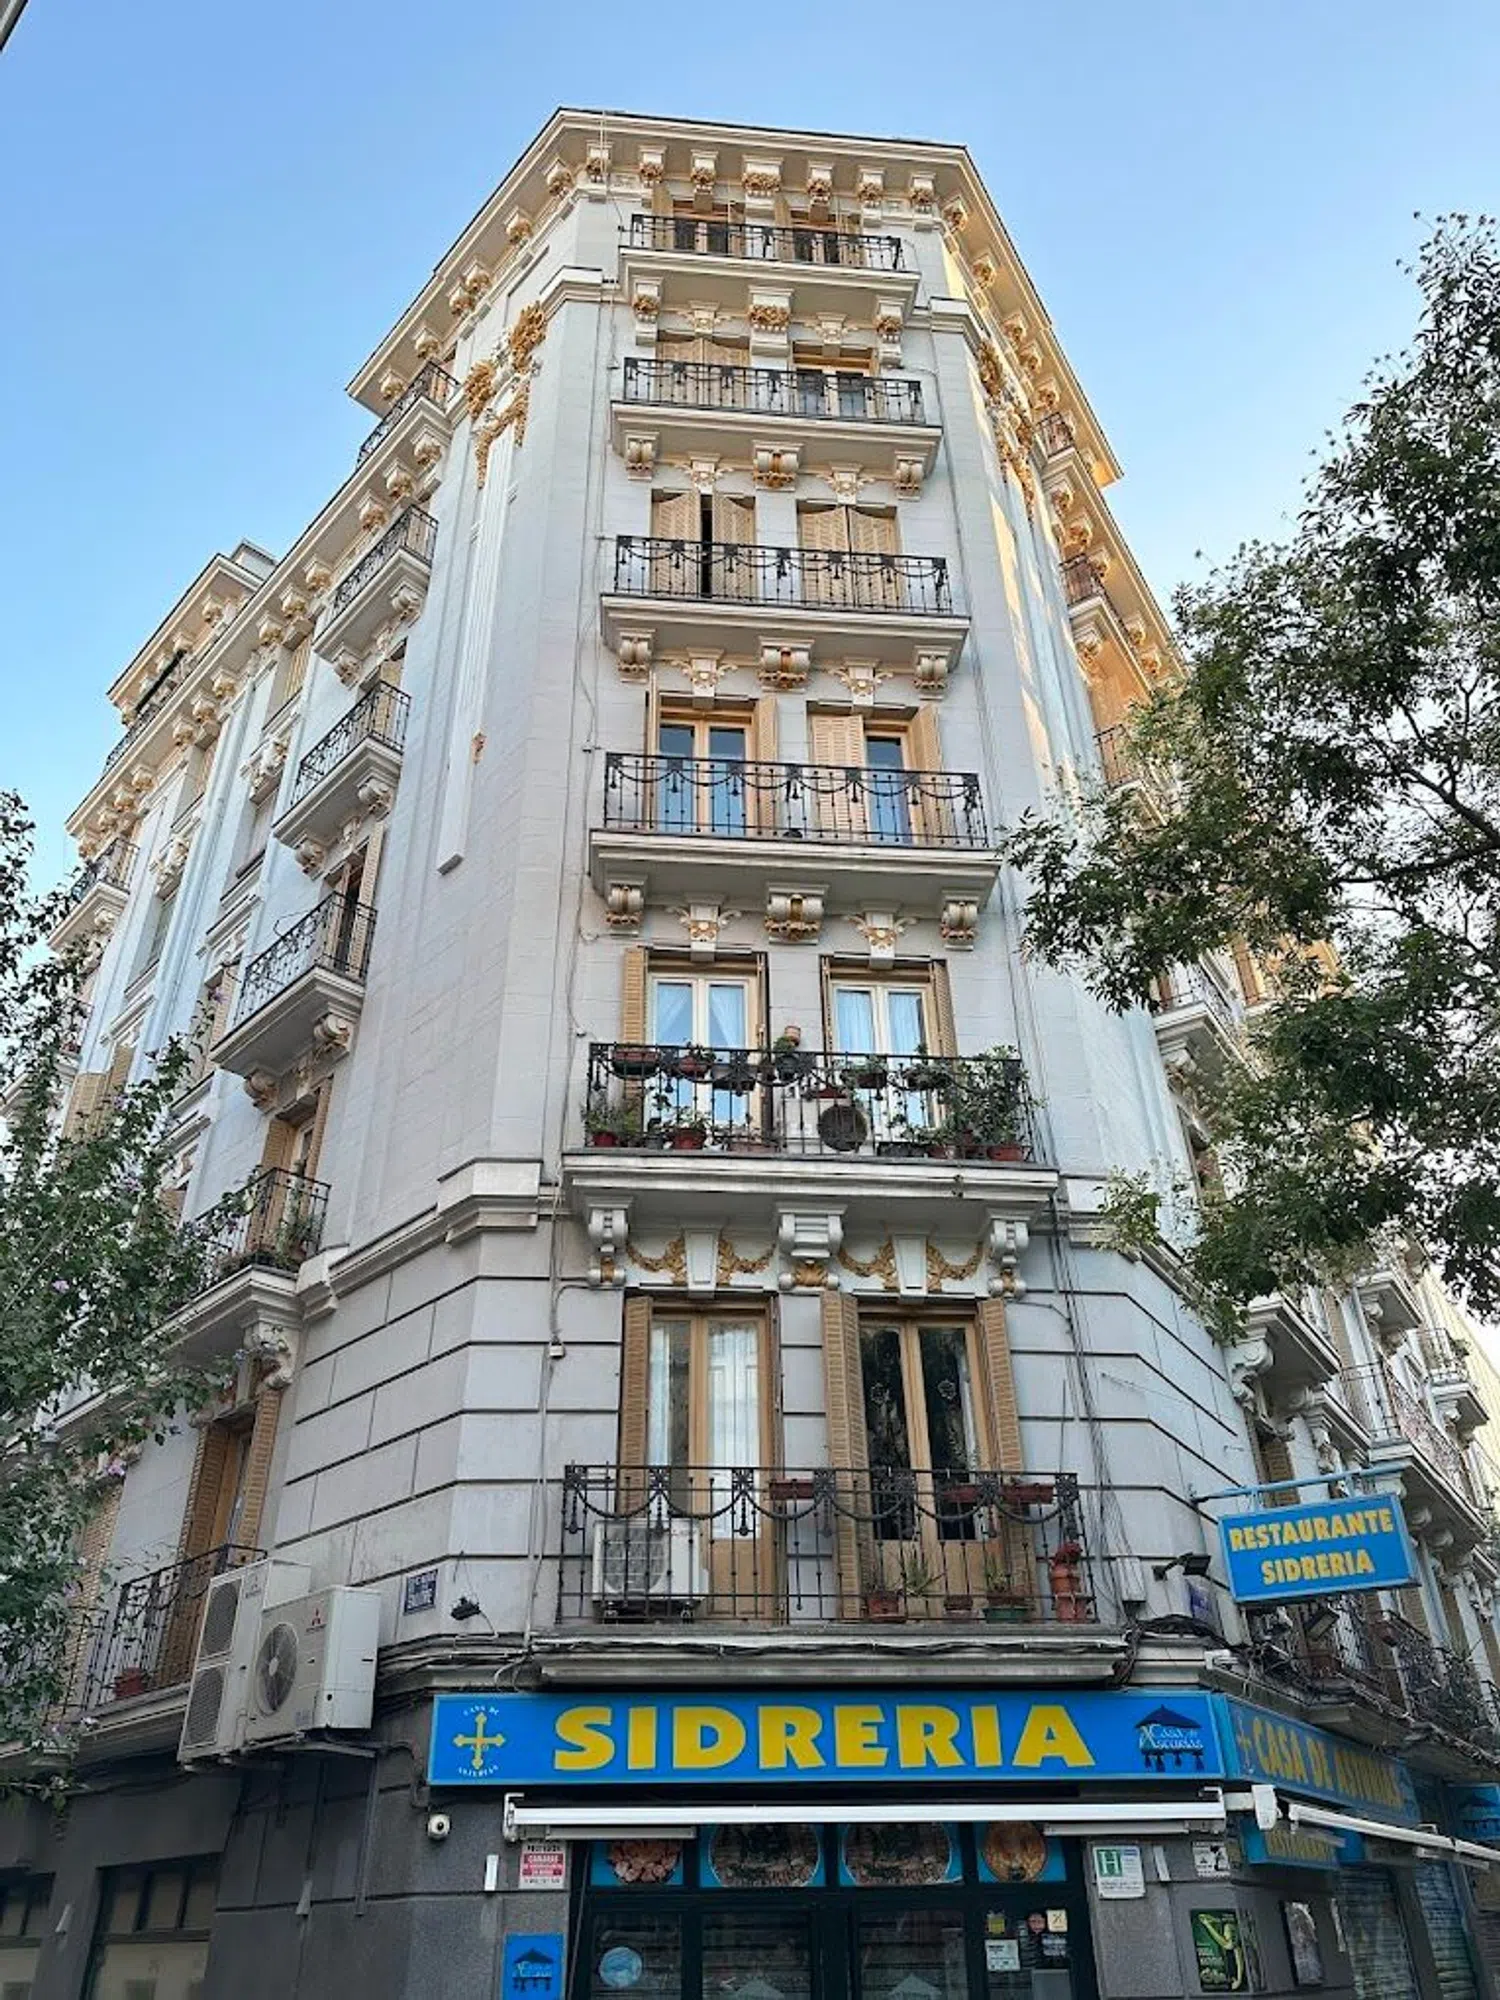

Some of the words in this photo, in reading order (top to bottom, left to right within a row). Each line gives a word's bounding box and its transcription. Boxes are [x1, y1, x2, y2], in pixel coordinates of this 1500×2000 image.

[1229, 1507, 1394, 1552] RESTAURANTE
[1261, 1548, 1375, 1586] SIDRERIA
[554, 1704, 1096, 1771] SIDRERIA
[1252, 1715, 1309, 1785] CASA
[1306, 1735, 1335, 1791] DE
